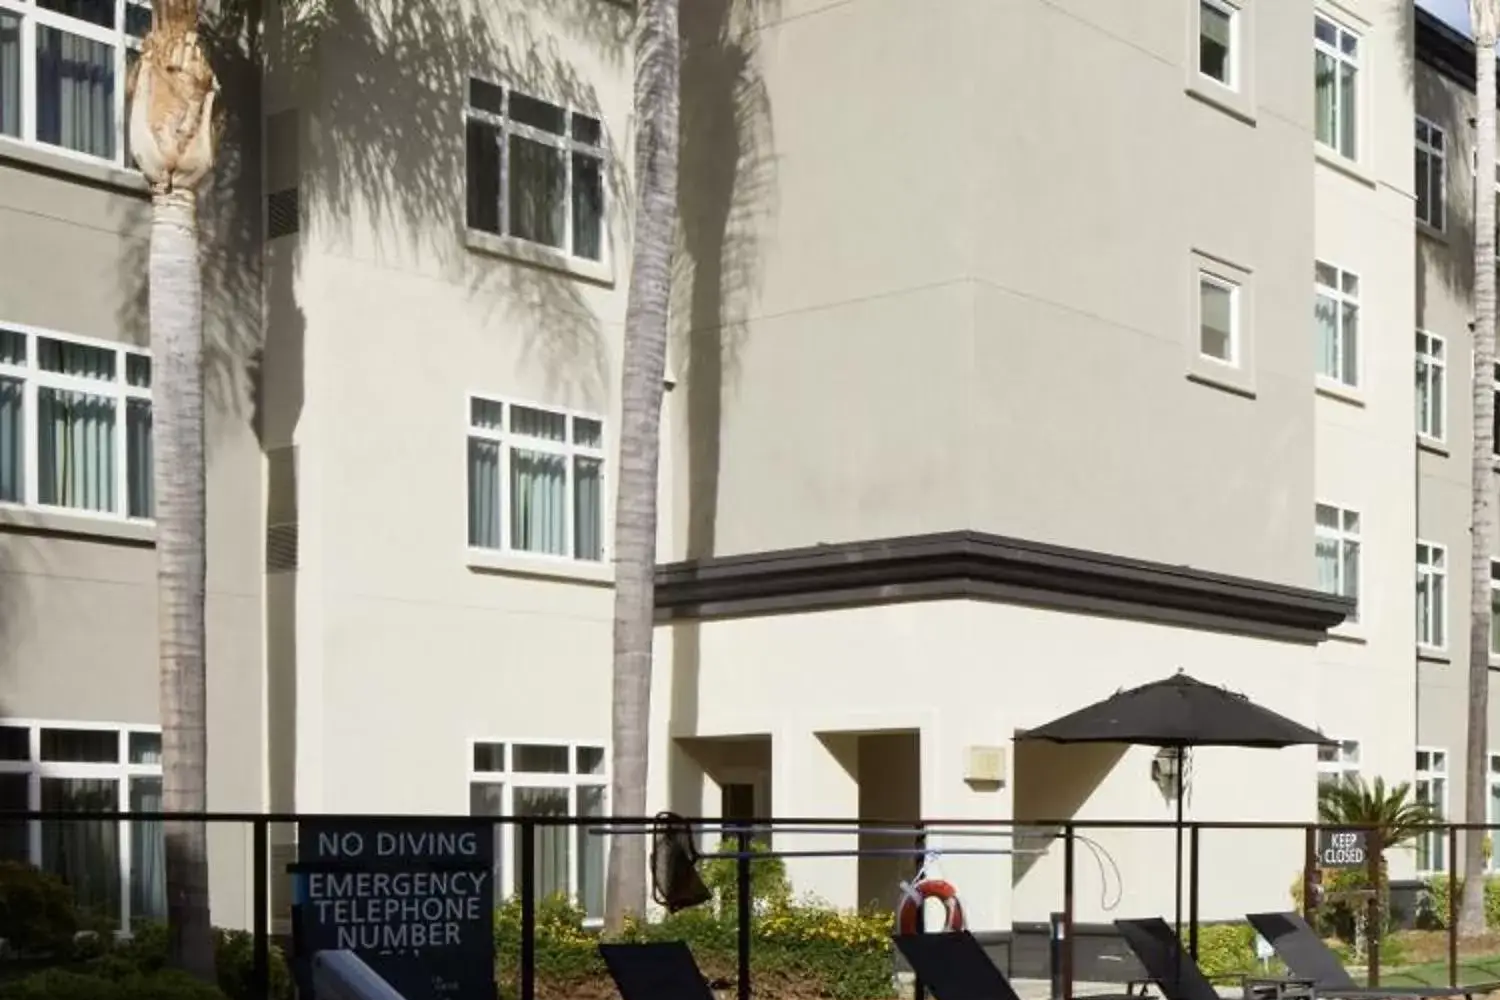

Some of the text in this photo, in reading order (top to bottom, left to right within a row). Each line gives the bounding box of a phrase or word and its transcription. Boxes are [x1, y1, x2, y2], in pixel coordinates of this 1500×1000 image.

[318, 832, 477, 856] NO DIVING
[1331, 833, 1357, 848] KEEP
[1324, 848, 1363, 863] CLOSED
[309, 872, 487, 898] EMERGENCY
[312, 898, 481, 925] TELEPHONE
[337, 922, 461, 949] NUMBER
